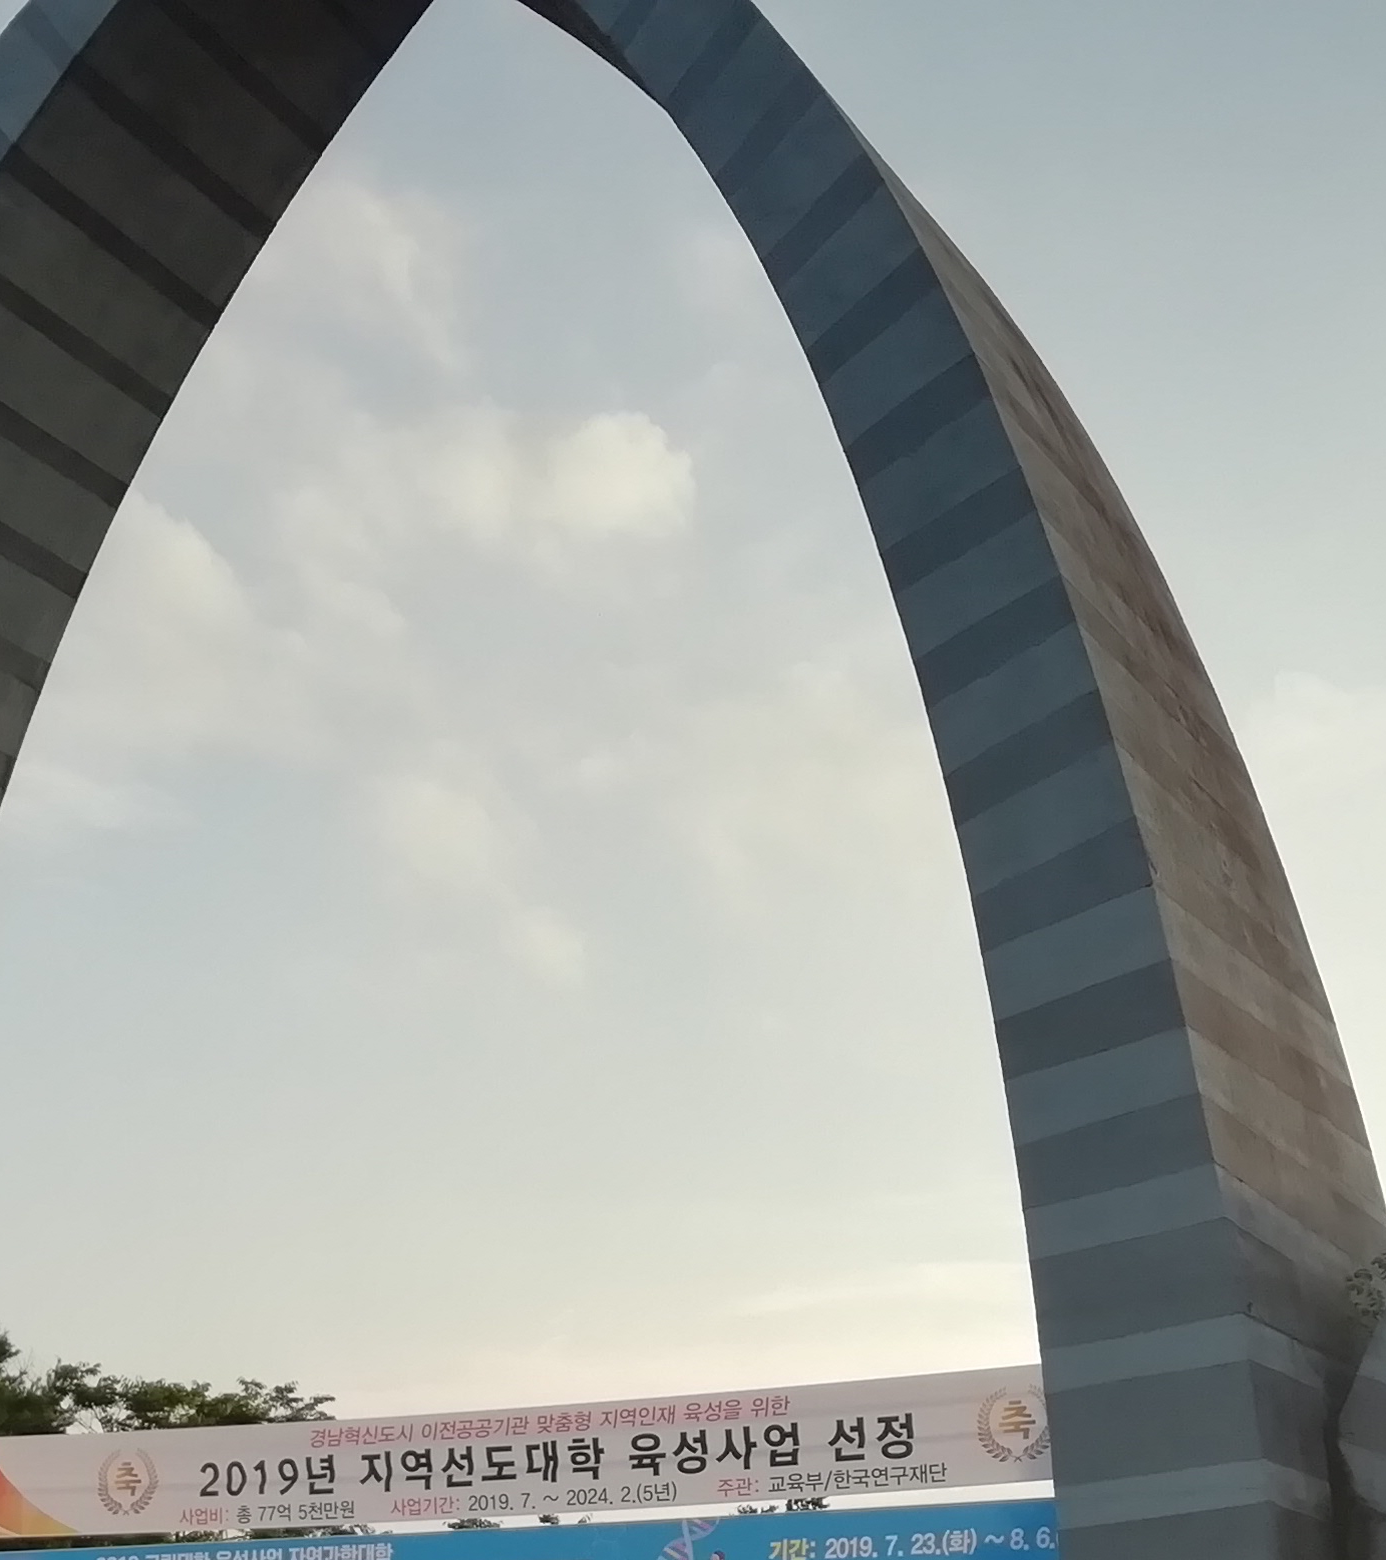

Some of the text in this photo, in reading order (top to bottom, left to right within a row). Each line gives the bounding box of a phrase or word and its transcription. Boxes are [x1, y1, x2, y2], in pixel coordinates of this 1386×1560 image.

[310, 1395, 790, 1449] 경남혁신도시 이전공공기관 맞춤형 지역인재 육성을 위한
[997, 1400, 1036, 1440] 축
[199, 1412, 915, 1498] 2019년 지역선도대학 육성사업 선정
[115, 1462, 142, 1497] 축
[716, 1462, 948, 1498] 주관: 교육부/한국연구재단
[179, 1500, 355, 1526] 사업비: 총 77억 5천만원
[390, 1496, 461, 1516] 사업기간:
[468, 1493, 514, 1512] 2019.
[566, 1487, 613, 1506] 2024.
[824, 1536, 878, 1559] 2019.
